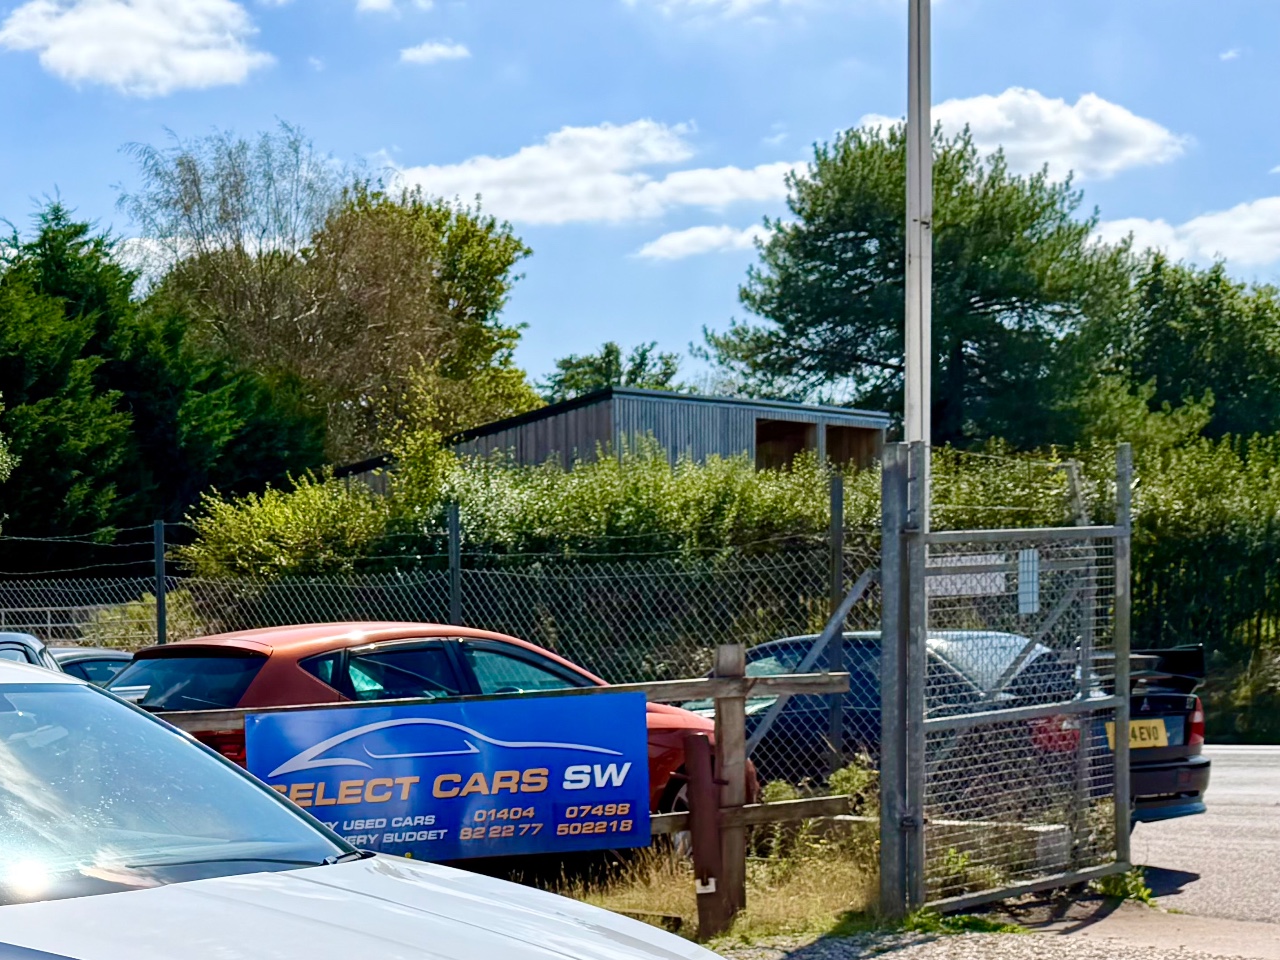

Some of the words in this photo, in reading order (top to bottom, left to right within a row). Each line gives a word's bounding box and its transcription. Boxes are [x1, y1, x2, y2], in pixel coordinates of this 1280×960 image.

[432, 767, 549, 798] CARS
[562, 762, 632, 790] SW
[473, 806, 535, 823] 01404
[565, 803, 631, 819] 07498
[342, 818, 387, 831] USED
[391, 815, 436, 828] CARS
[556, 819, 633, 836] 502218
[382, 829, 448, 844] BUDGET
